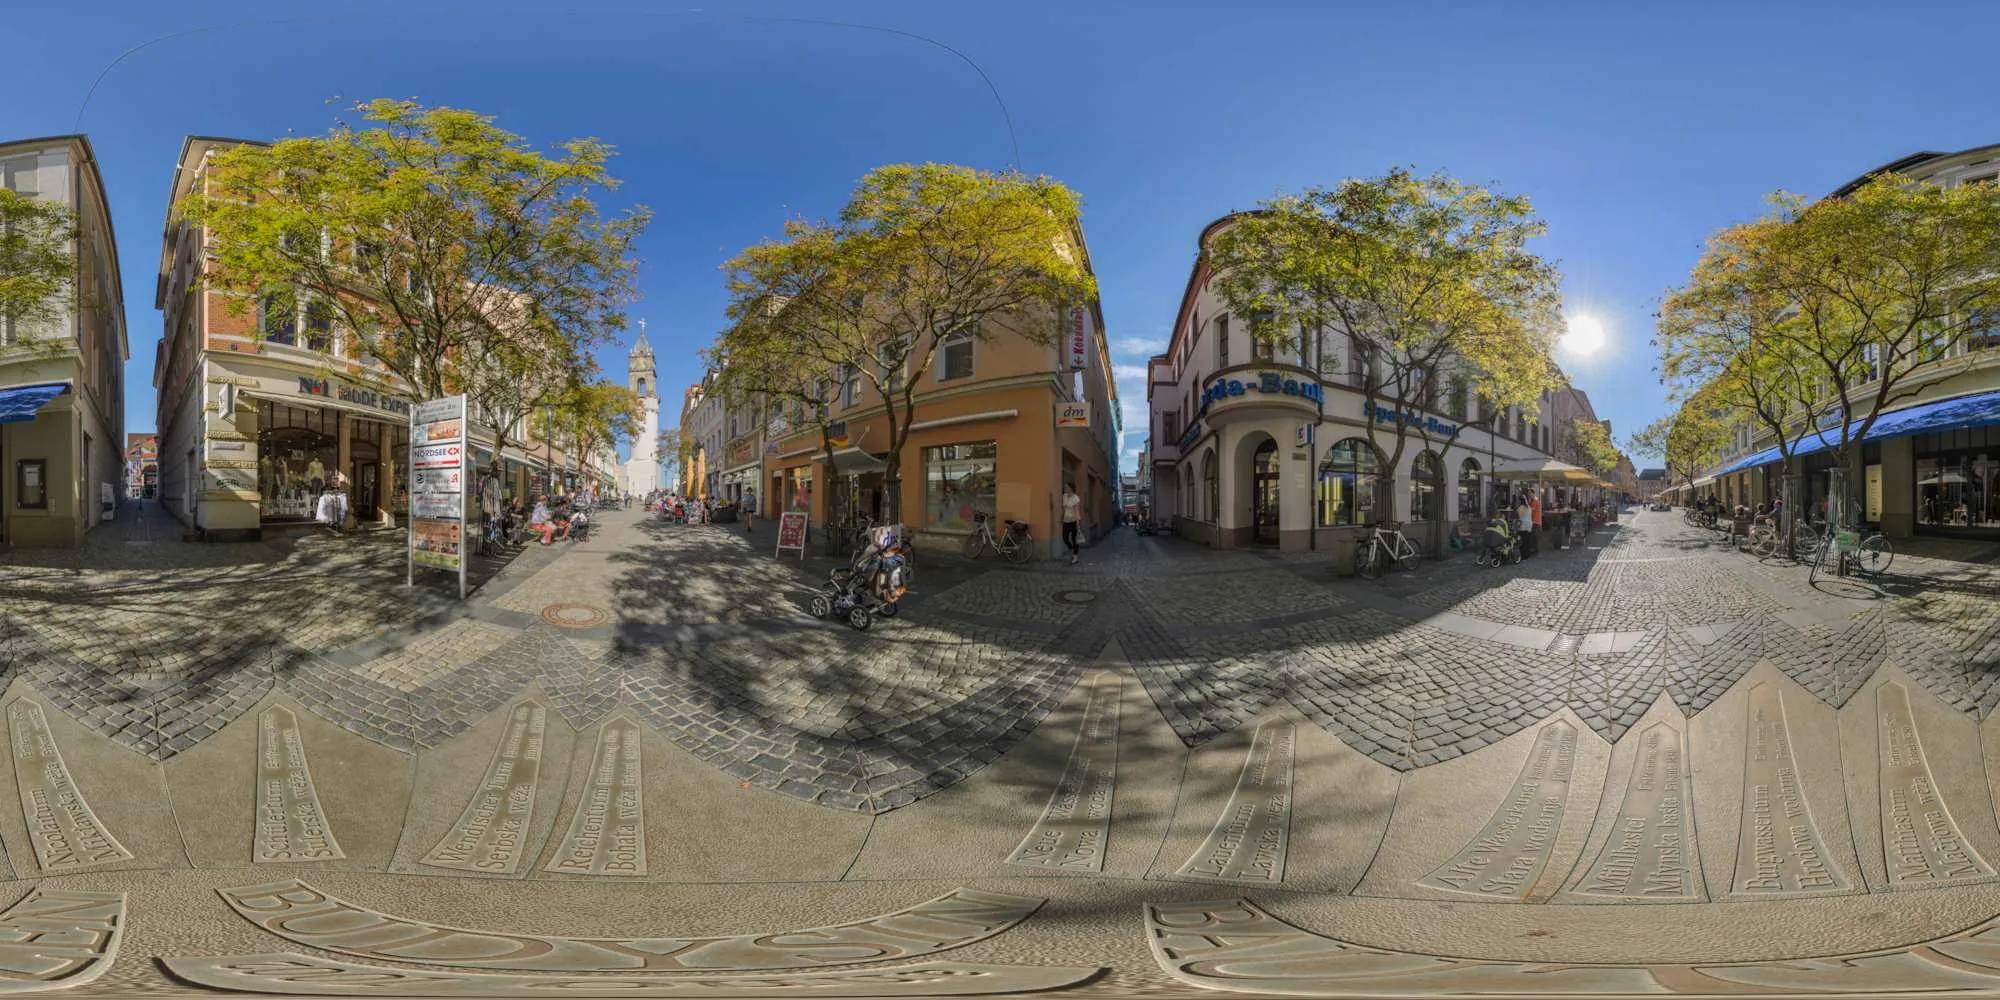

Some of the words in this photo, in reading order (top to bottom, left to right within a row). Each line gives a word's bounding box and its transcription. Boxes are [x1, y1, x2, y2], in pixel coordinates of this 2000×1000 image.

[1063, 406, 1085, 418] dm
[414, 448, 447, 458] NORDSEE
[30, 788, 80, 868] Nicolaiturm
[260, 779, 292, 859] Schülerturm
[433, 793, 503, 862] Wendischer
[484, 761, 514, 791] Turm
[475, 818, 524, 870] Serbska
[555, 787, 610, 870] Reichenturm
[604, 824, 638, 873] Bohata
[1016, 830, 1063, 865] Neue
[1060, 830, 1100, 869] Nowa
[1188, 803, 1255, 877] Lauenturm
[1434, 856, 1493, 889] Alte
[1468, 781, 1542, 855] Wasserkunst
[1743, 783, 1785, 890] Burgwasserturm
[1889, 788, 1935, 880] Matthiasturm
[1476, 856, 1537, 896] Stara
[1585, 815, 1648, 894] Mühlbastei
[1787, 824, 1839, 890] Hrodowa
[225, 887, 1035, 970] BUDYSIN
